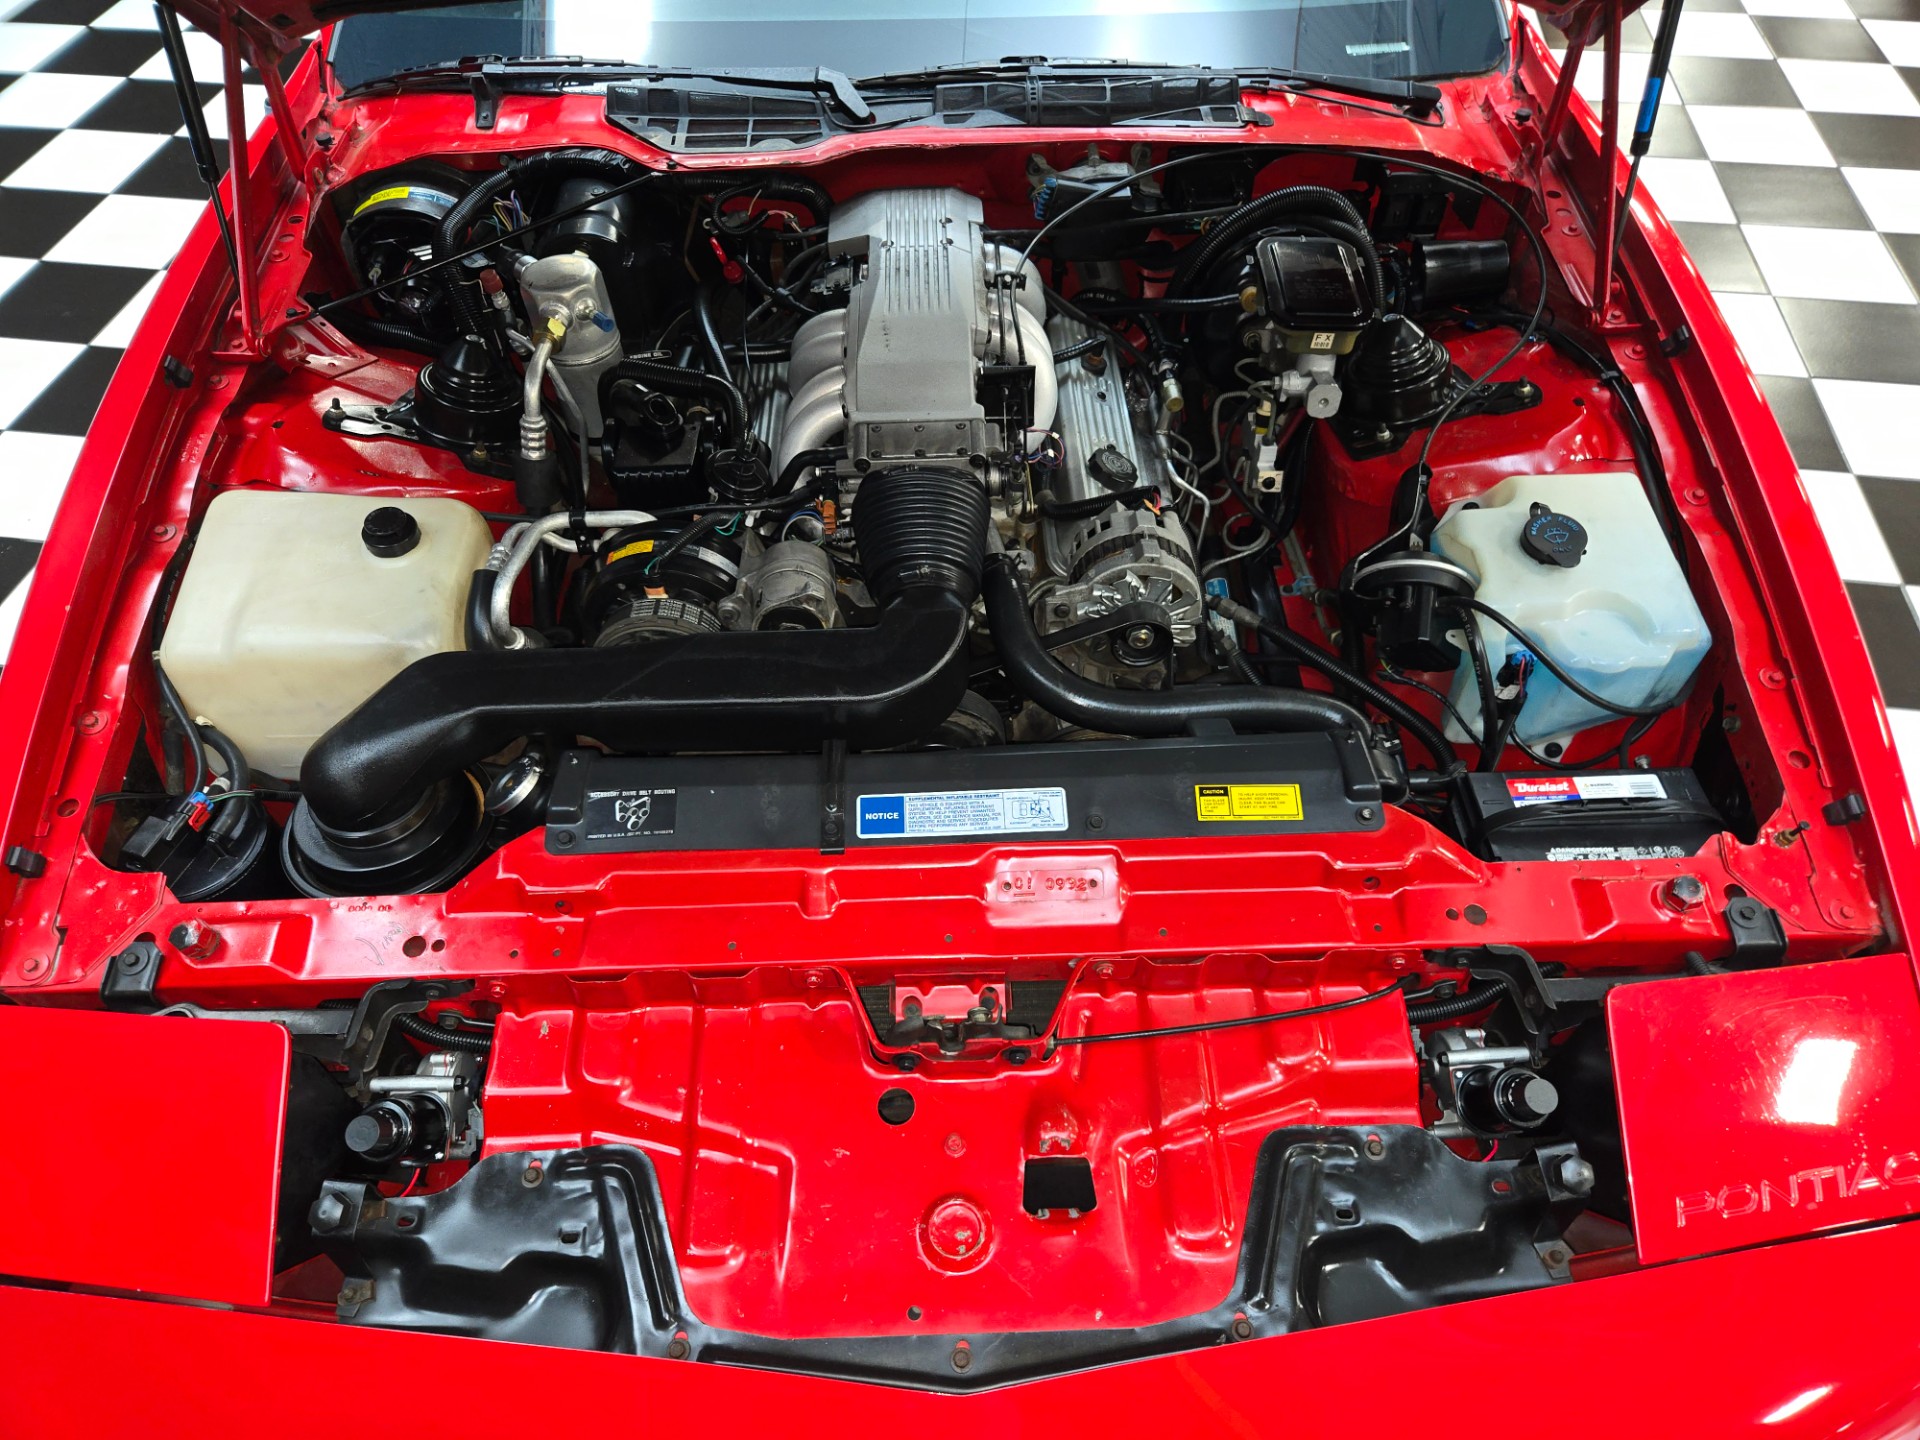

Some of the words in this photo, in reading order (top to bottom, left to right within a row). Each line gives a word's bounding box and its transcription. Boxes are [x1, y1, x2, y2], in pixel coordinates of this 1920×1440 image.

[1530, 516, 1552, 536] WASHER
[1558, 516, 1579, 531] FLUID
[1514, 782, 1569, 792] Duralast
[1676, 1152, 1920, 1228] PONTIAC
